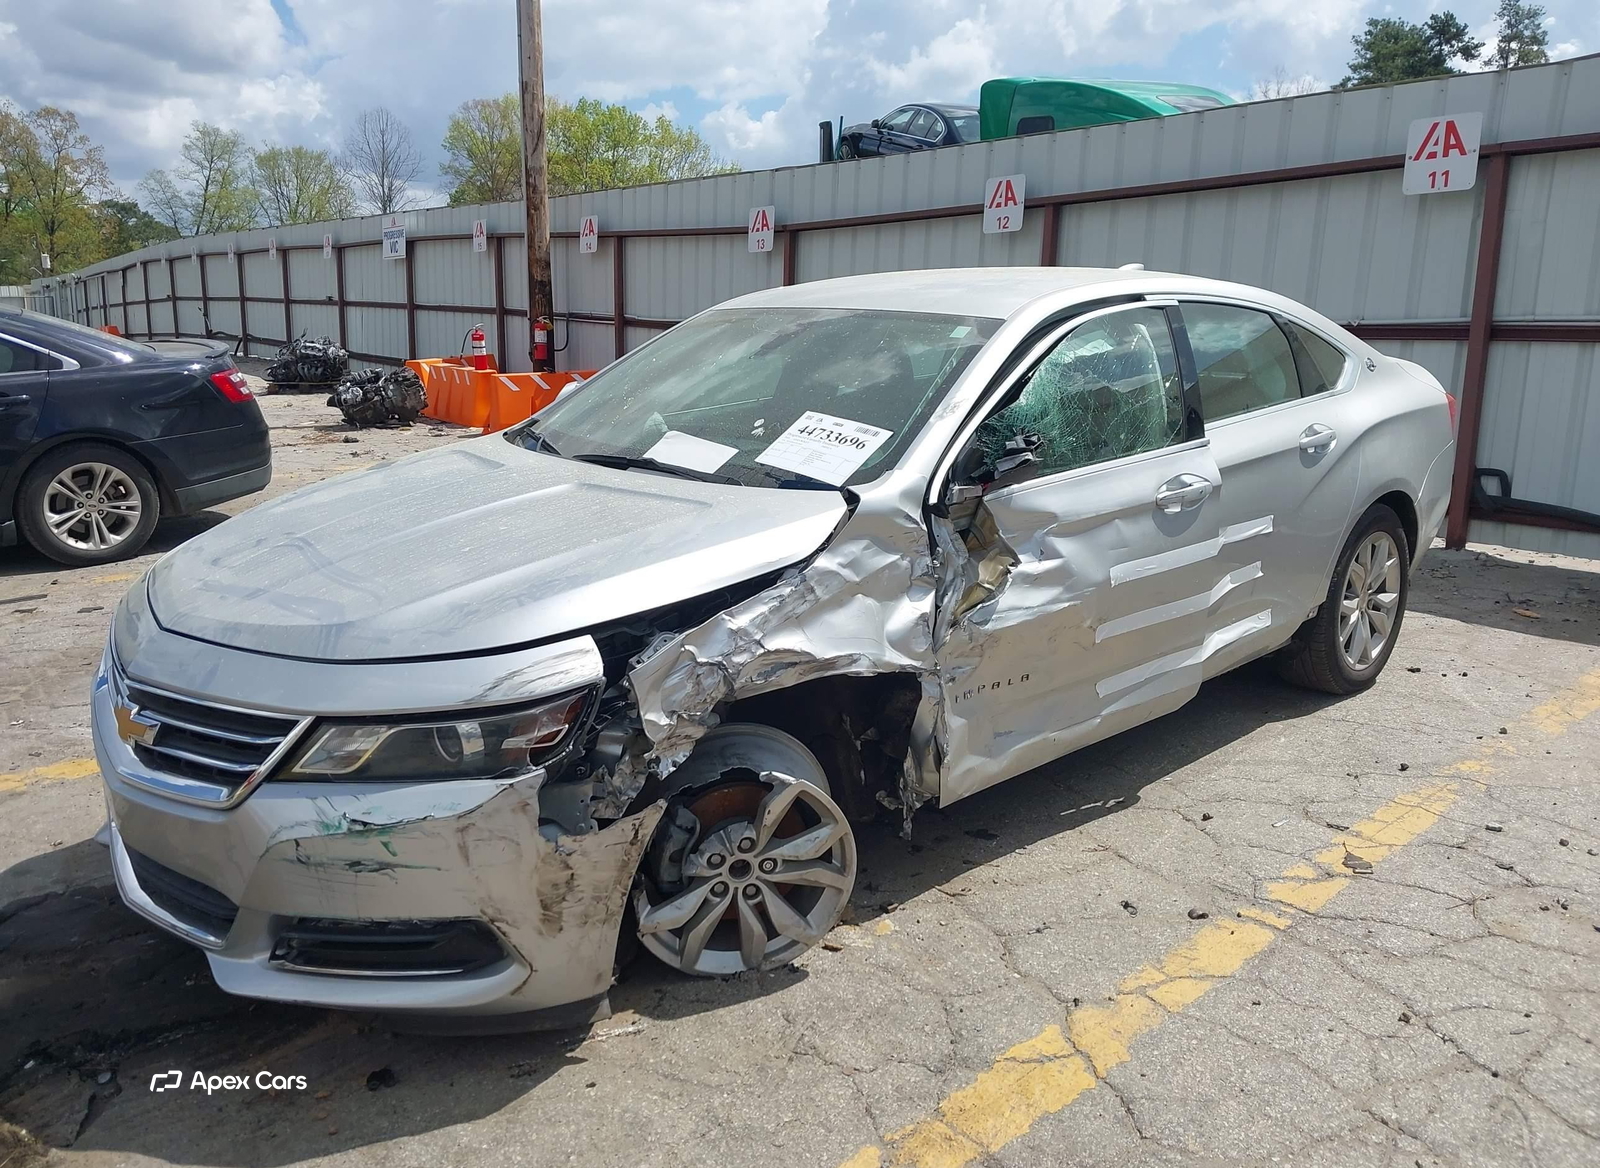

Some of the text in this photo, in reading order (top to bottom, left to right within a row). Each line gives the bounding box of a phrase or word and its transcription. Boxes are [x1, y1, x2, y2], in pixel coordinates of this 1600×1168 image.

[1428, 169, 1450, 189] 11
[996, 215, 1010, 230] 12
[383, 229, 404, 240] PROGRESSIVE
[390, 240, 399, 254] VIC
[756, 238, 765, 250] 13
[798, 425, 869, 449] 44733696
[955, 673, 1029, 703] IMPALA
